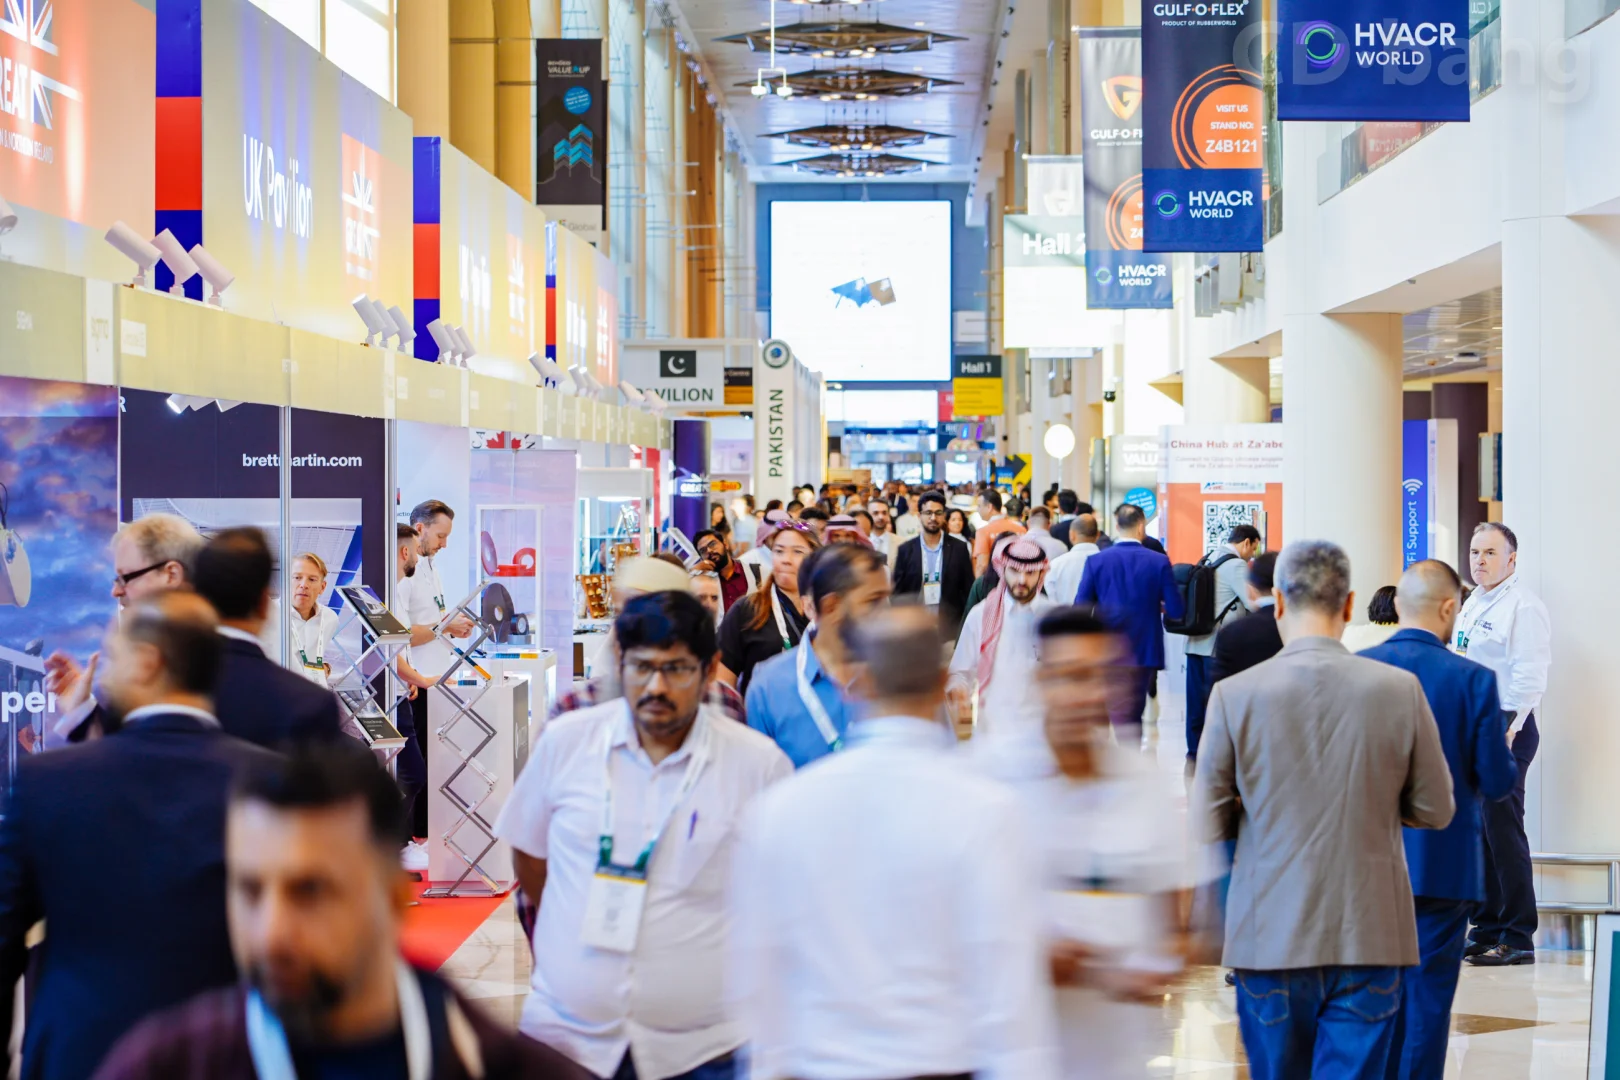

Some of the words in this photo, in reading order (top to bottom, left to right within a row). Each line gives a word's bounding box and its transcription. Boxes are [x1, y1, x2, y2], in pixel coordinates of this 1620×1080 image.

[1354, 22, 1455, 47] HVACR
[1356, 51, 1424, 66] WORLD
[1216, 104, 1236, 112] VISIT
[1237, 104, 1248, 112] US
[1210, 121, 1237, 130] STAND
[1205, 140, 1258, 153] Z4B121
[243, 133, 264, 221] UK
[266, 145, 313, 239] Pavilion
[1189, 190, 1253, 206] HVACR
[1189, 208, 1234, 219] WORLD
[1023, 233, 1070, 255] Hall
[1118, 265, 1166, 277] HVACR
[1119, 278, 1152, 286] WORLD
[961, 362, 984, 373] Hall
[986, 362, 992, 372] 1
[636, 388, 713, 402] VILION
[769, 389, 783, 478] PAKISTAN
[1171, 440, 1203, 449] China
[1206, 440, 1228, 449] Hub
[1232, 441, 1243, 449] at
[1406, 501, 1420, 549] Support
